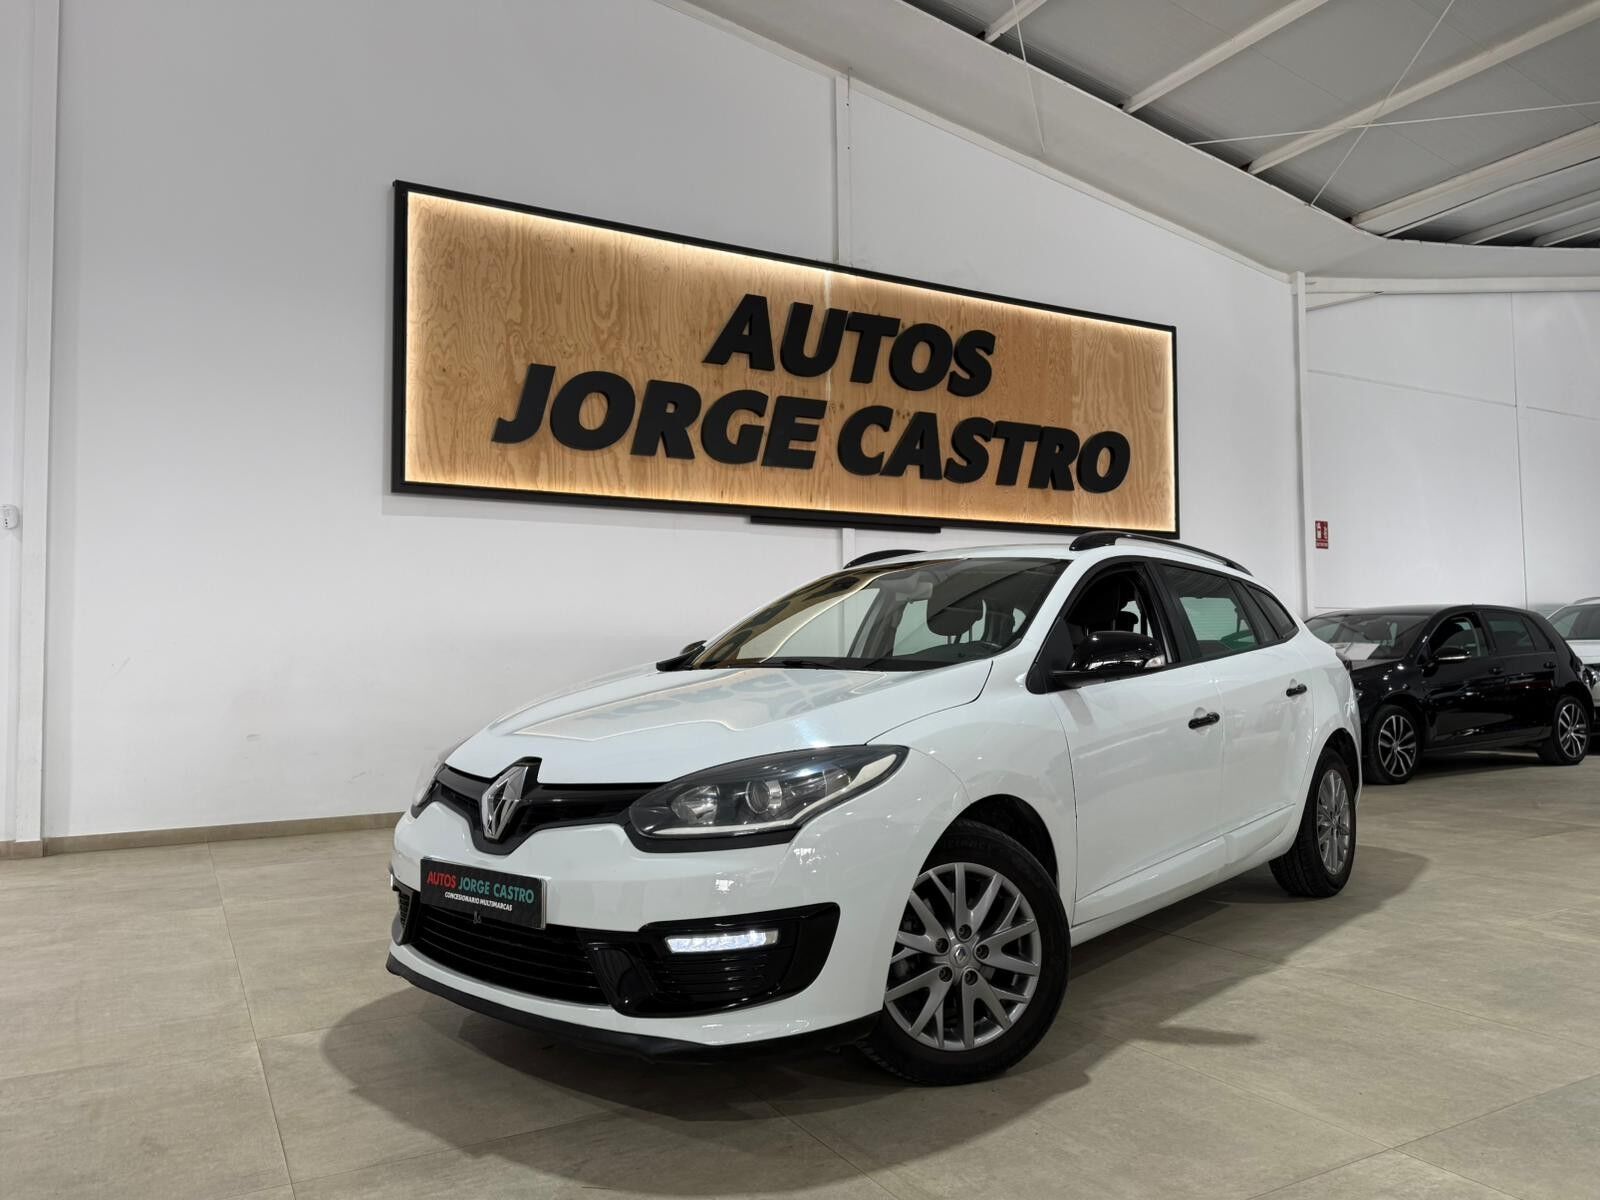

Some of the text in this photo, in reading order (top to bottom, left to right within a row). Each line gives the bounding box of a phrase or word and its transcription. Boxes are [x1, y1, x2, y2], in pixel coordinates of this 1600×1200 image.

[702, 293, 996, 398] AUTOS
[491, 363, 1131, 494] JORGE CASTRO
[427, 871, 534, 903] AUTOS JORGE CASTRO
[445, 892, 512, 911] CONCESIONARIO MULTIMARCAS
